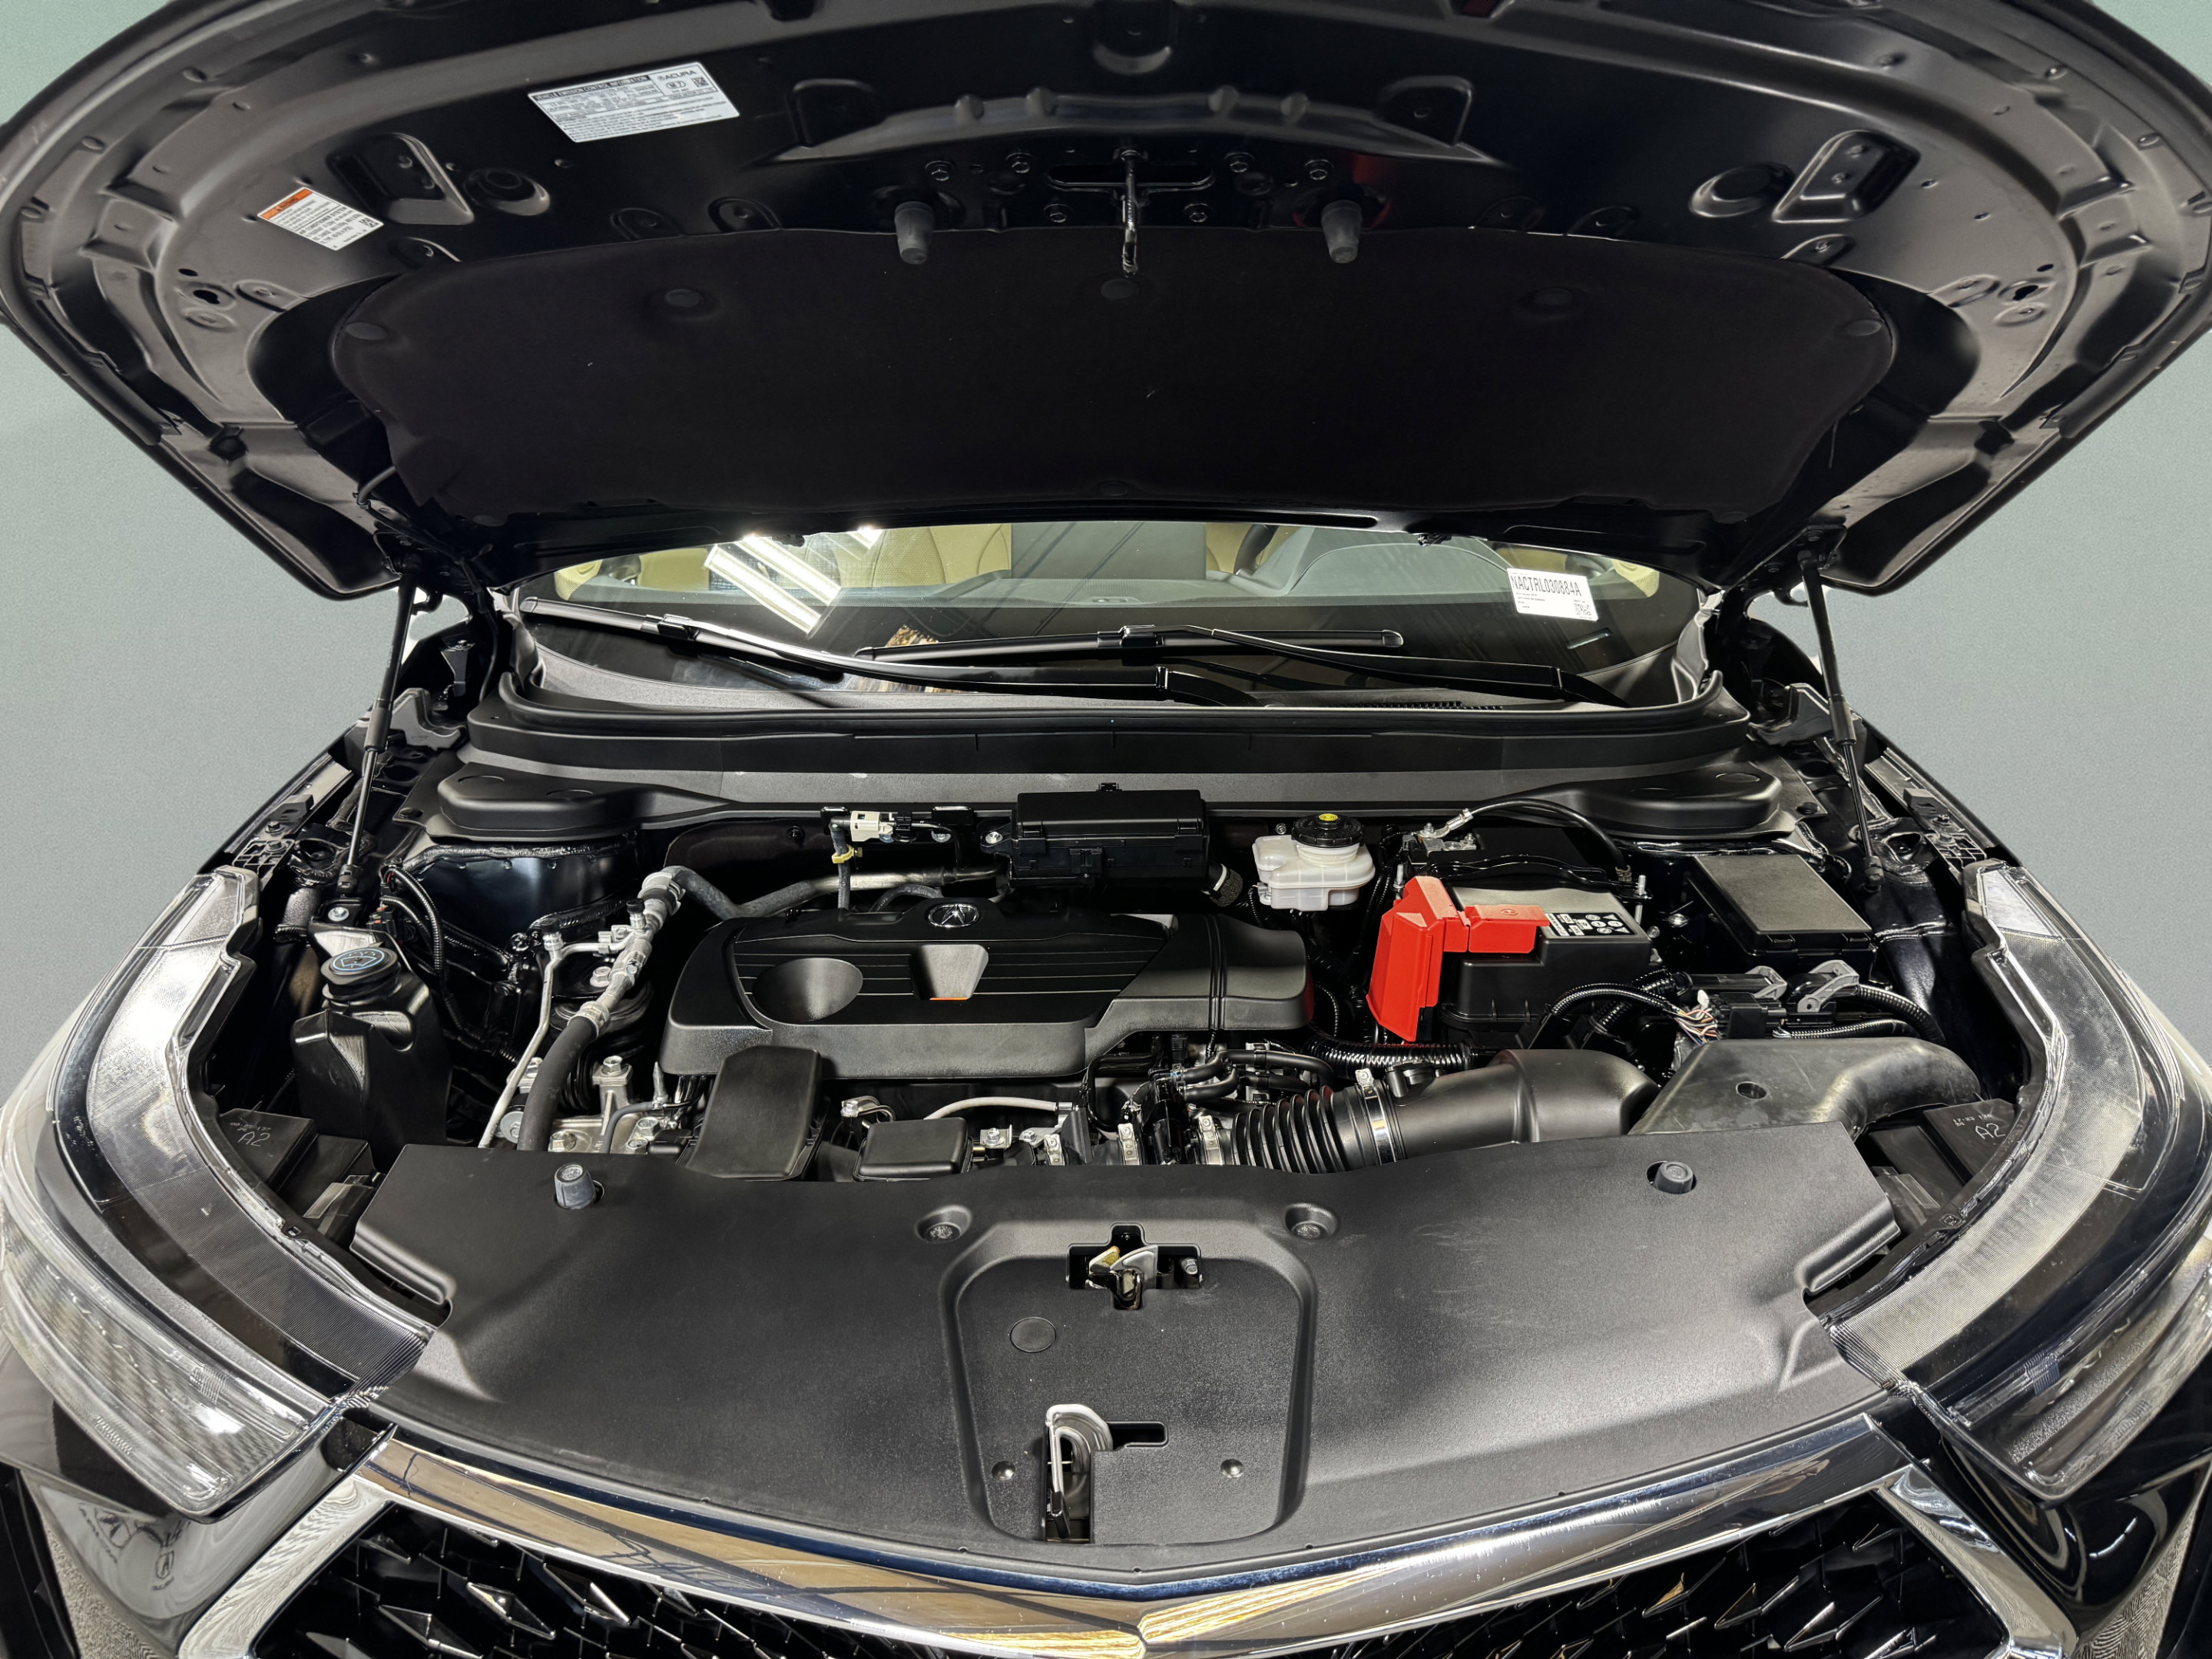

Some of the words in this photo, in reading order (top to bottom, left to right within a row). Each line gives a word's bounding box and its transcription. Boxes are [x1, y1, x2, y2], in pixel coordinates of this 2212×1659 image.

[664, 70, 697, 80] ACURA
[535, 91, 558, 101] VEHICLE
[558, 87, 584, 97] EMISSION
[583, 82, 609, 92] CONTROL
[609, 76, 647, 87] INFORMATION
[1510, 575, 1582, 597] NACTRL030884A
[237, 1131, 270, 1147] A2
[1975, 1123, 2006, 1140] A2
